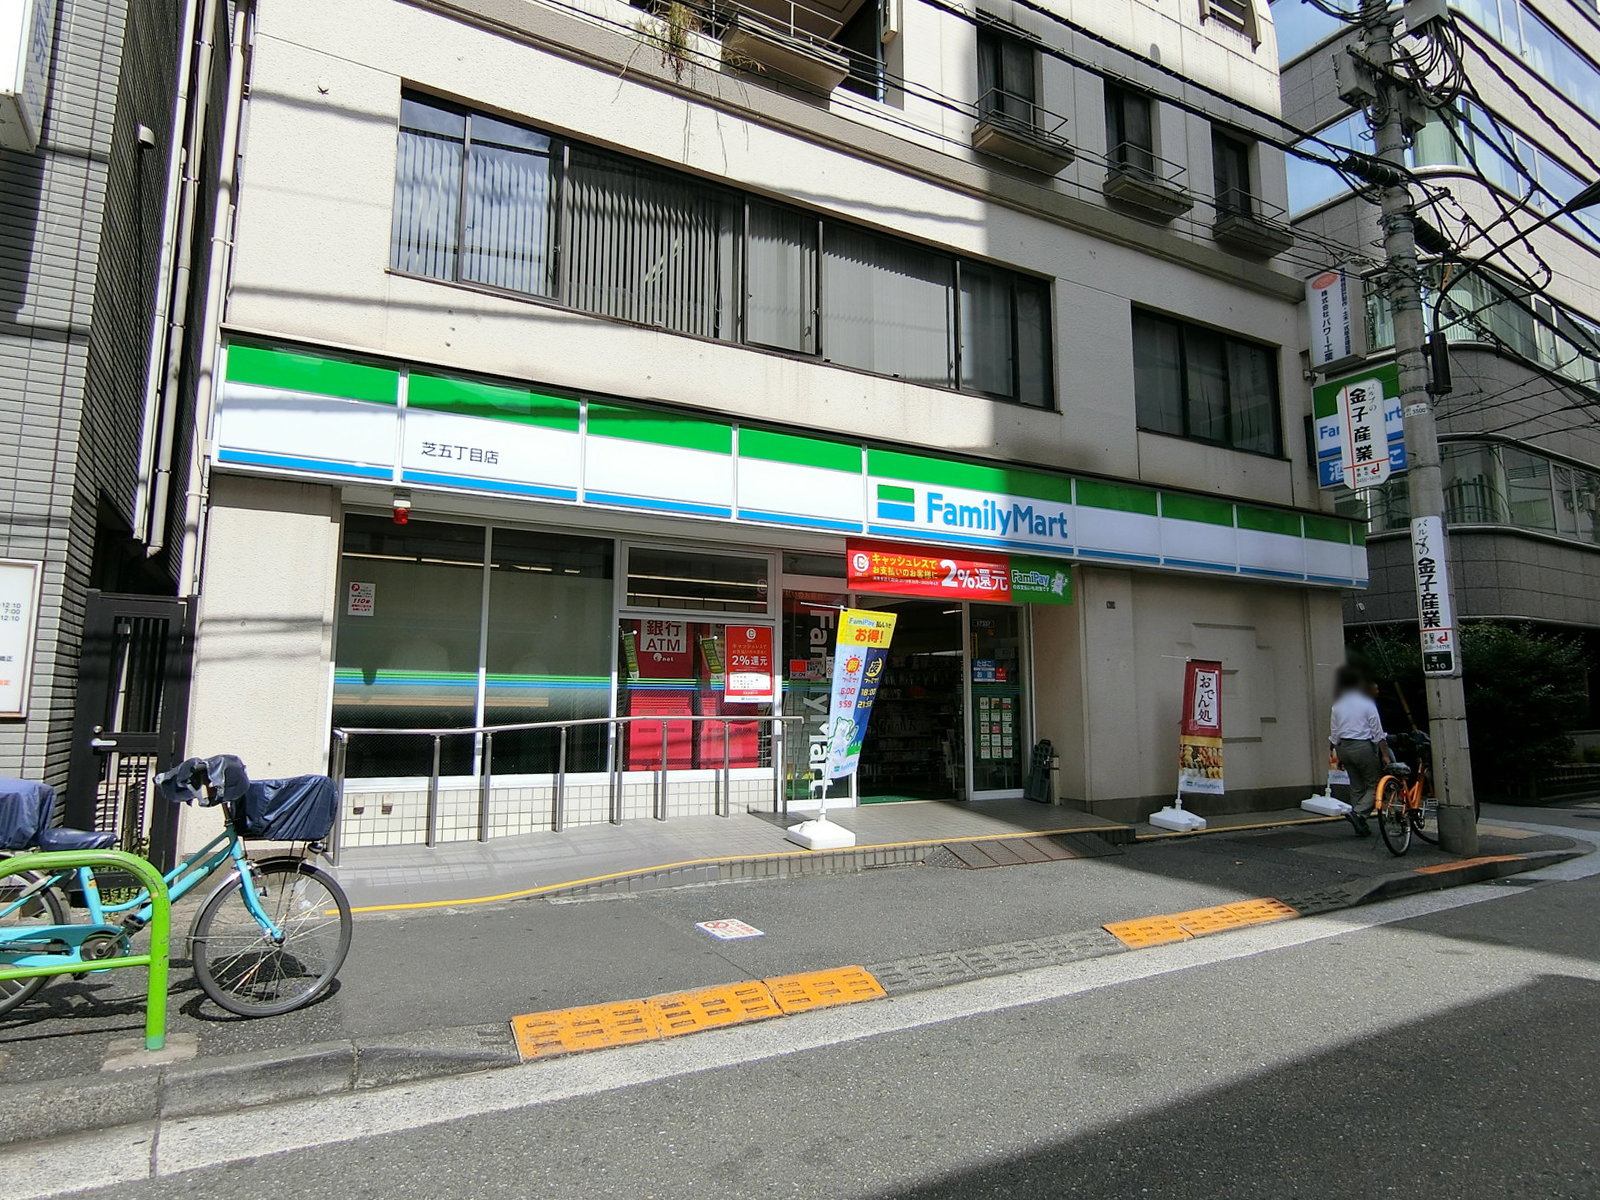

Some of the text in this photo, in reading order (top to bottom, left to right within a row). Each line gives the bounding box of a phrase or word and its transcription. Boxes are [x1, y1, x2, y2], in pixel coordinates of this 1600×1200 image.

[1349, 388, 1373, 463] 金子産業
[421, 441, 499, 465] 芝五丁目店
[926, 491, 1068, 539] FamilyMart
[872, 553, 938, 570] キャッシュレスで
[872, 566, 938, 580] お支払いのお客様に
[940, 559, 1008, 591] 2%還元
[1011, 570, 1050, 586] FamiPay
[1418, 557, 1440, 629] 金子産業
[647, 619, 682, 637] 銀行
[849, 617, 875, 627] FamiPay
[855, 628, 884, 644] お得!
[646, 638, 681, 652] ATM
[732, 655, 768, 666] 2%還元
[1198, 675, 1216, 723] おでん処
